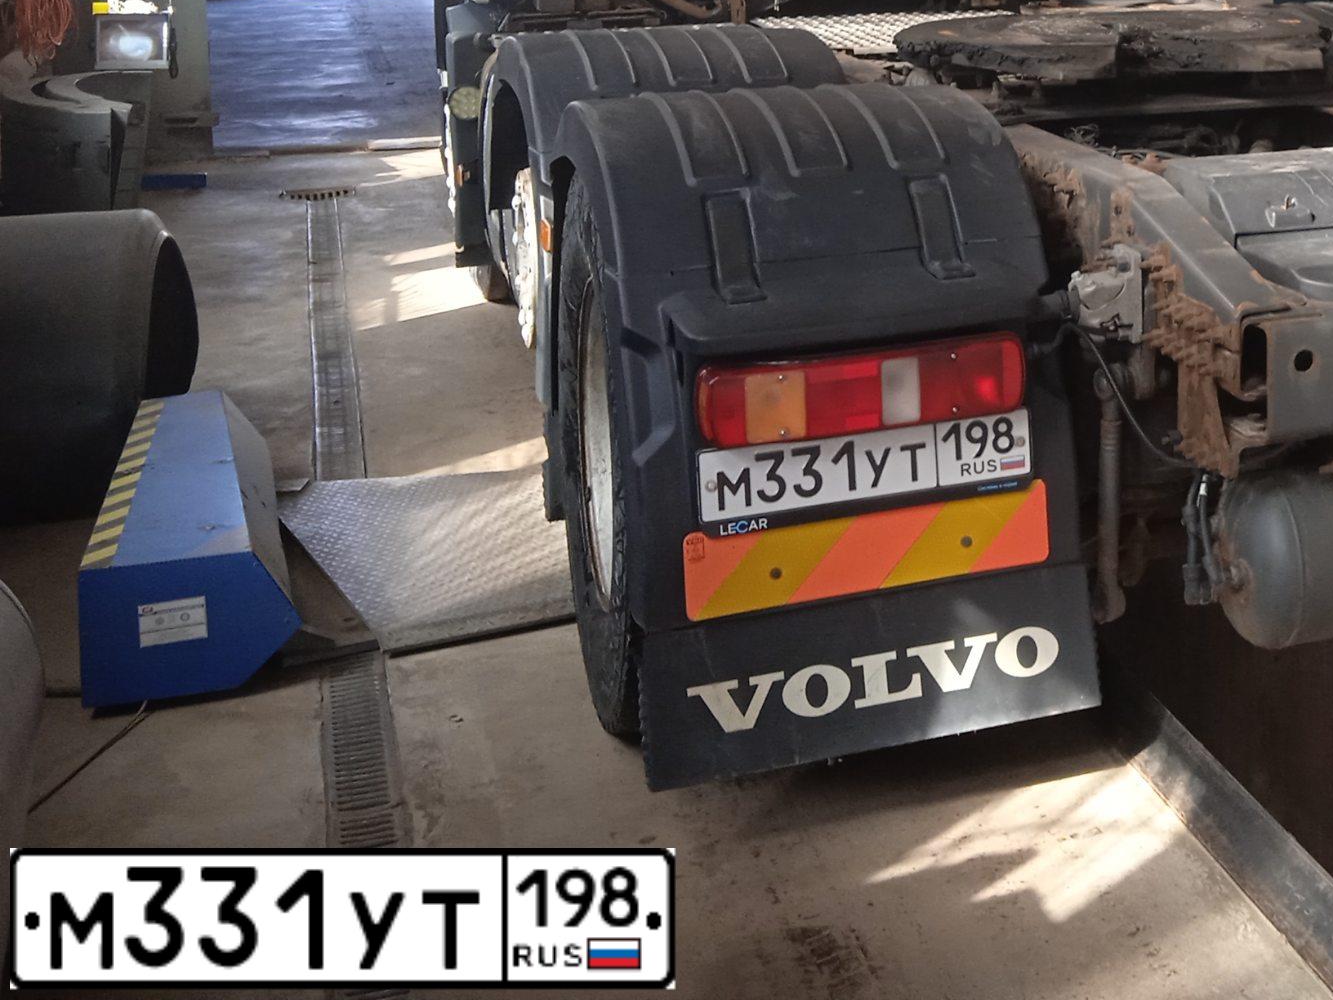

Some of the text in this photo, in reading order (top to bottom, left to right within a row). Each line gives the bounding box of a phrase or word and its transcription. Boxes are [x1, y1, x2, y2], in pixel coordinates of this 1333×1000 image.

[941, 416, 1015, 461] 198
[960, 458, 998, 477] RUS
[720, 518, 768, 536] LECAR
[686, 626, 1060, 734] VOLVO
